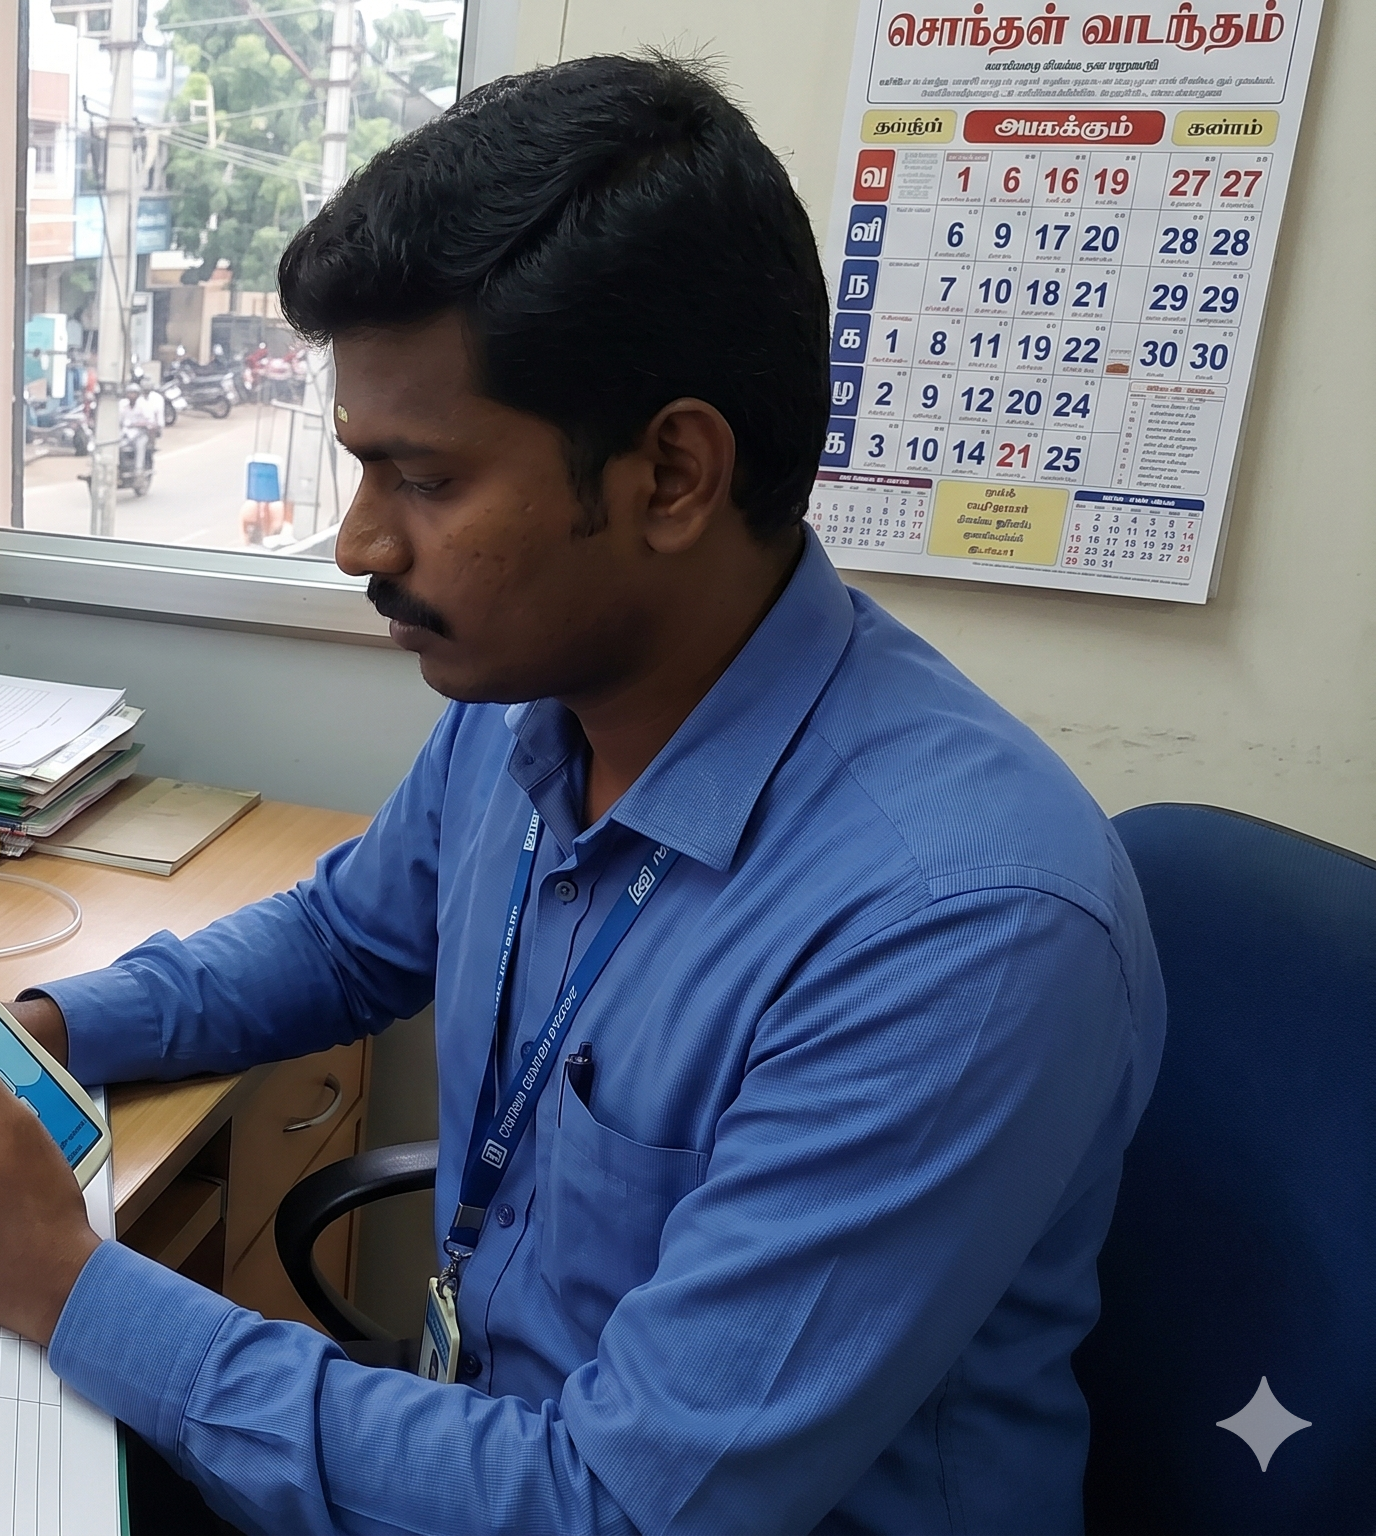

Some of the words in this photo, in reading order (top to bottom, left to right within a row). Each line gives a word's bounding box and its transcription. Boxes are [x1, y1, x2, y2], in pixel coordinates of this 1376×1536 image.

[861, 167, 887, 188] வ
[957, 167, 971, 192] 1
[1003, 167, 1021, 192] 6
[1045, 168, 1079, 193] 16
[1094, 168, 1129, 194] 19
[1169, 170, 1210, 197] 27
[1221, 170, 1262, 197] 27
[948, 222, 964, 247] 6
[994, 223, 1012, 248] 9
[1036, 224, 1071, 250] 17
[1081, 226, 1119, 251] 20
[1159, 228, 1198, 254] 28
[1210, 229, 1250, 256] 28
[940, 277, 957, 301] 7
[979, 278, 1012, 304] 10
[1026, 280, 1060, 305] 18
[1072, 282, 1108, 308] 21
[1149, 284, 1188, 311] 29
[1199, 286, 1239, 313] 29
[886, 329, 898, 353] 1
[930, 331, 947, 355] 8
[970, 333, 1001, 358] 11
[1018, 335, 1051, 360] 19
[1062, 338, 1100, 363] 22
[1140, 341, 1178, 367] 30
[1190, 343, 1228, 370] 30
[875, 382, 892, 406] 2
[922, 385, 938, 408] 9
[961, 387, 994, 413] 12
[1005, 390, 1041, 415] 20
[1053, 393, 1090, 418] 24
[868, 434, 885, 457] 3
[906, 437, 938, 462] 10
[952, 440, 985, 465] 14
[996, 443, 1030, 468] 21
[1044, 446, 1081, 472] 25
[1109, 526, 1120, 534] 10
[1164, 531, 1175, 539] 13
[1102, 560, 1113, 568] 31
